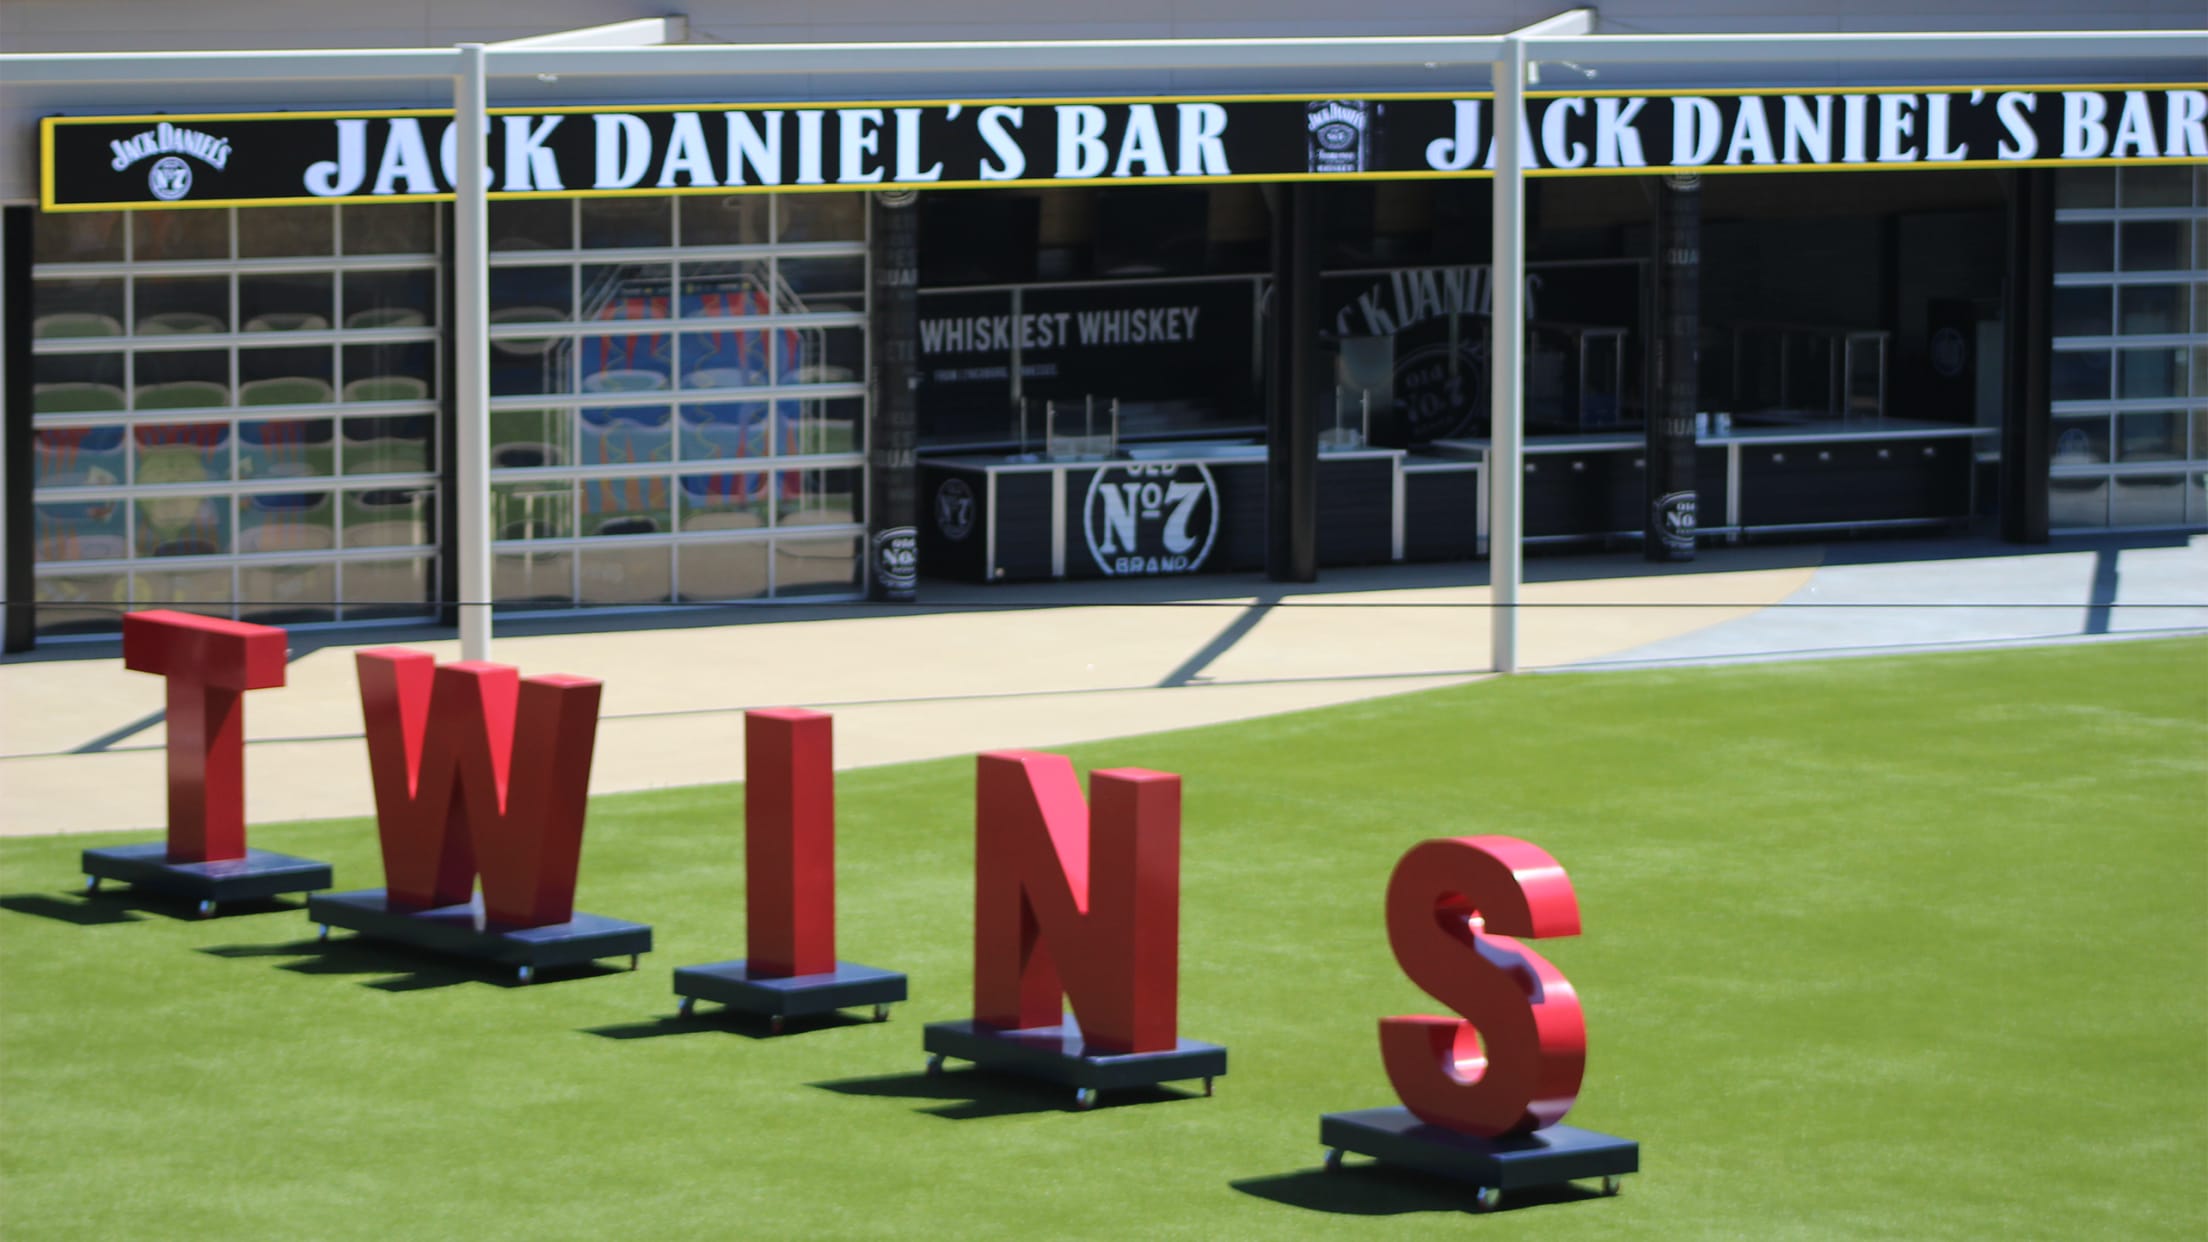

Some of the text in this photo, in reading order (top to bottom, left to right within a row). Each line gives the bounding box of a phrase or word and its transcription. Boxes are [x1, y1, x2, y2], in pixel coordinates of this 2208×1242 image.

[592, 103, 1026, 189] DANIEL'S
[1054, 103, 1231, 179] BAR
[1669, 89, 2038, 166] DANIEL'S
[2060, 90, 2208, 158] BAR
[110, 130, 159, 172] JACK
[1077, 306, 1199, 345] WHISKEY
[1115, 556, 1189, 573] BRAND
